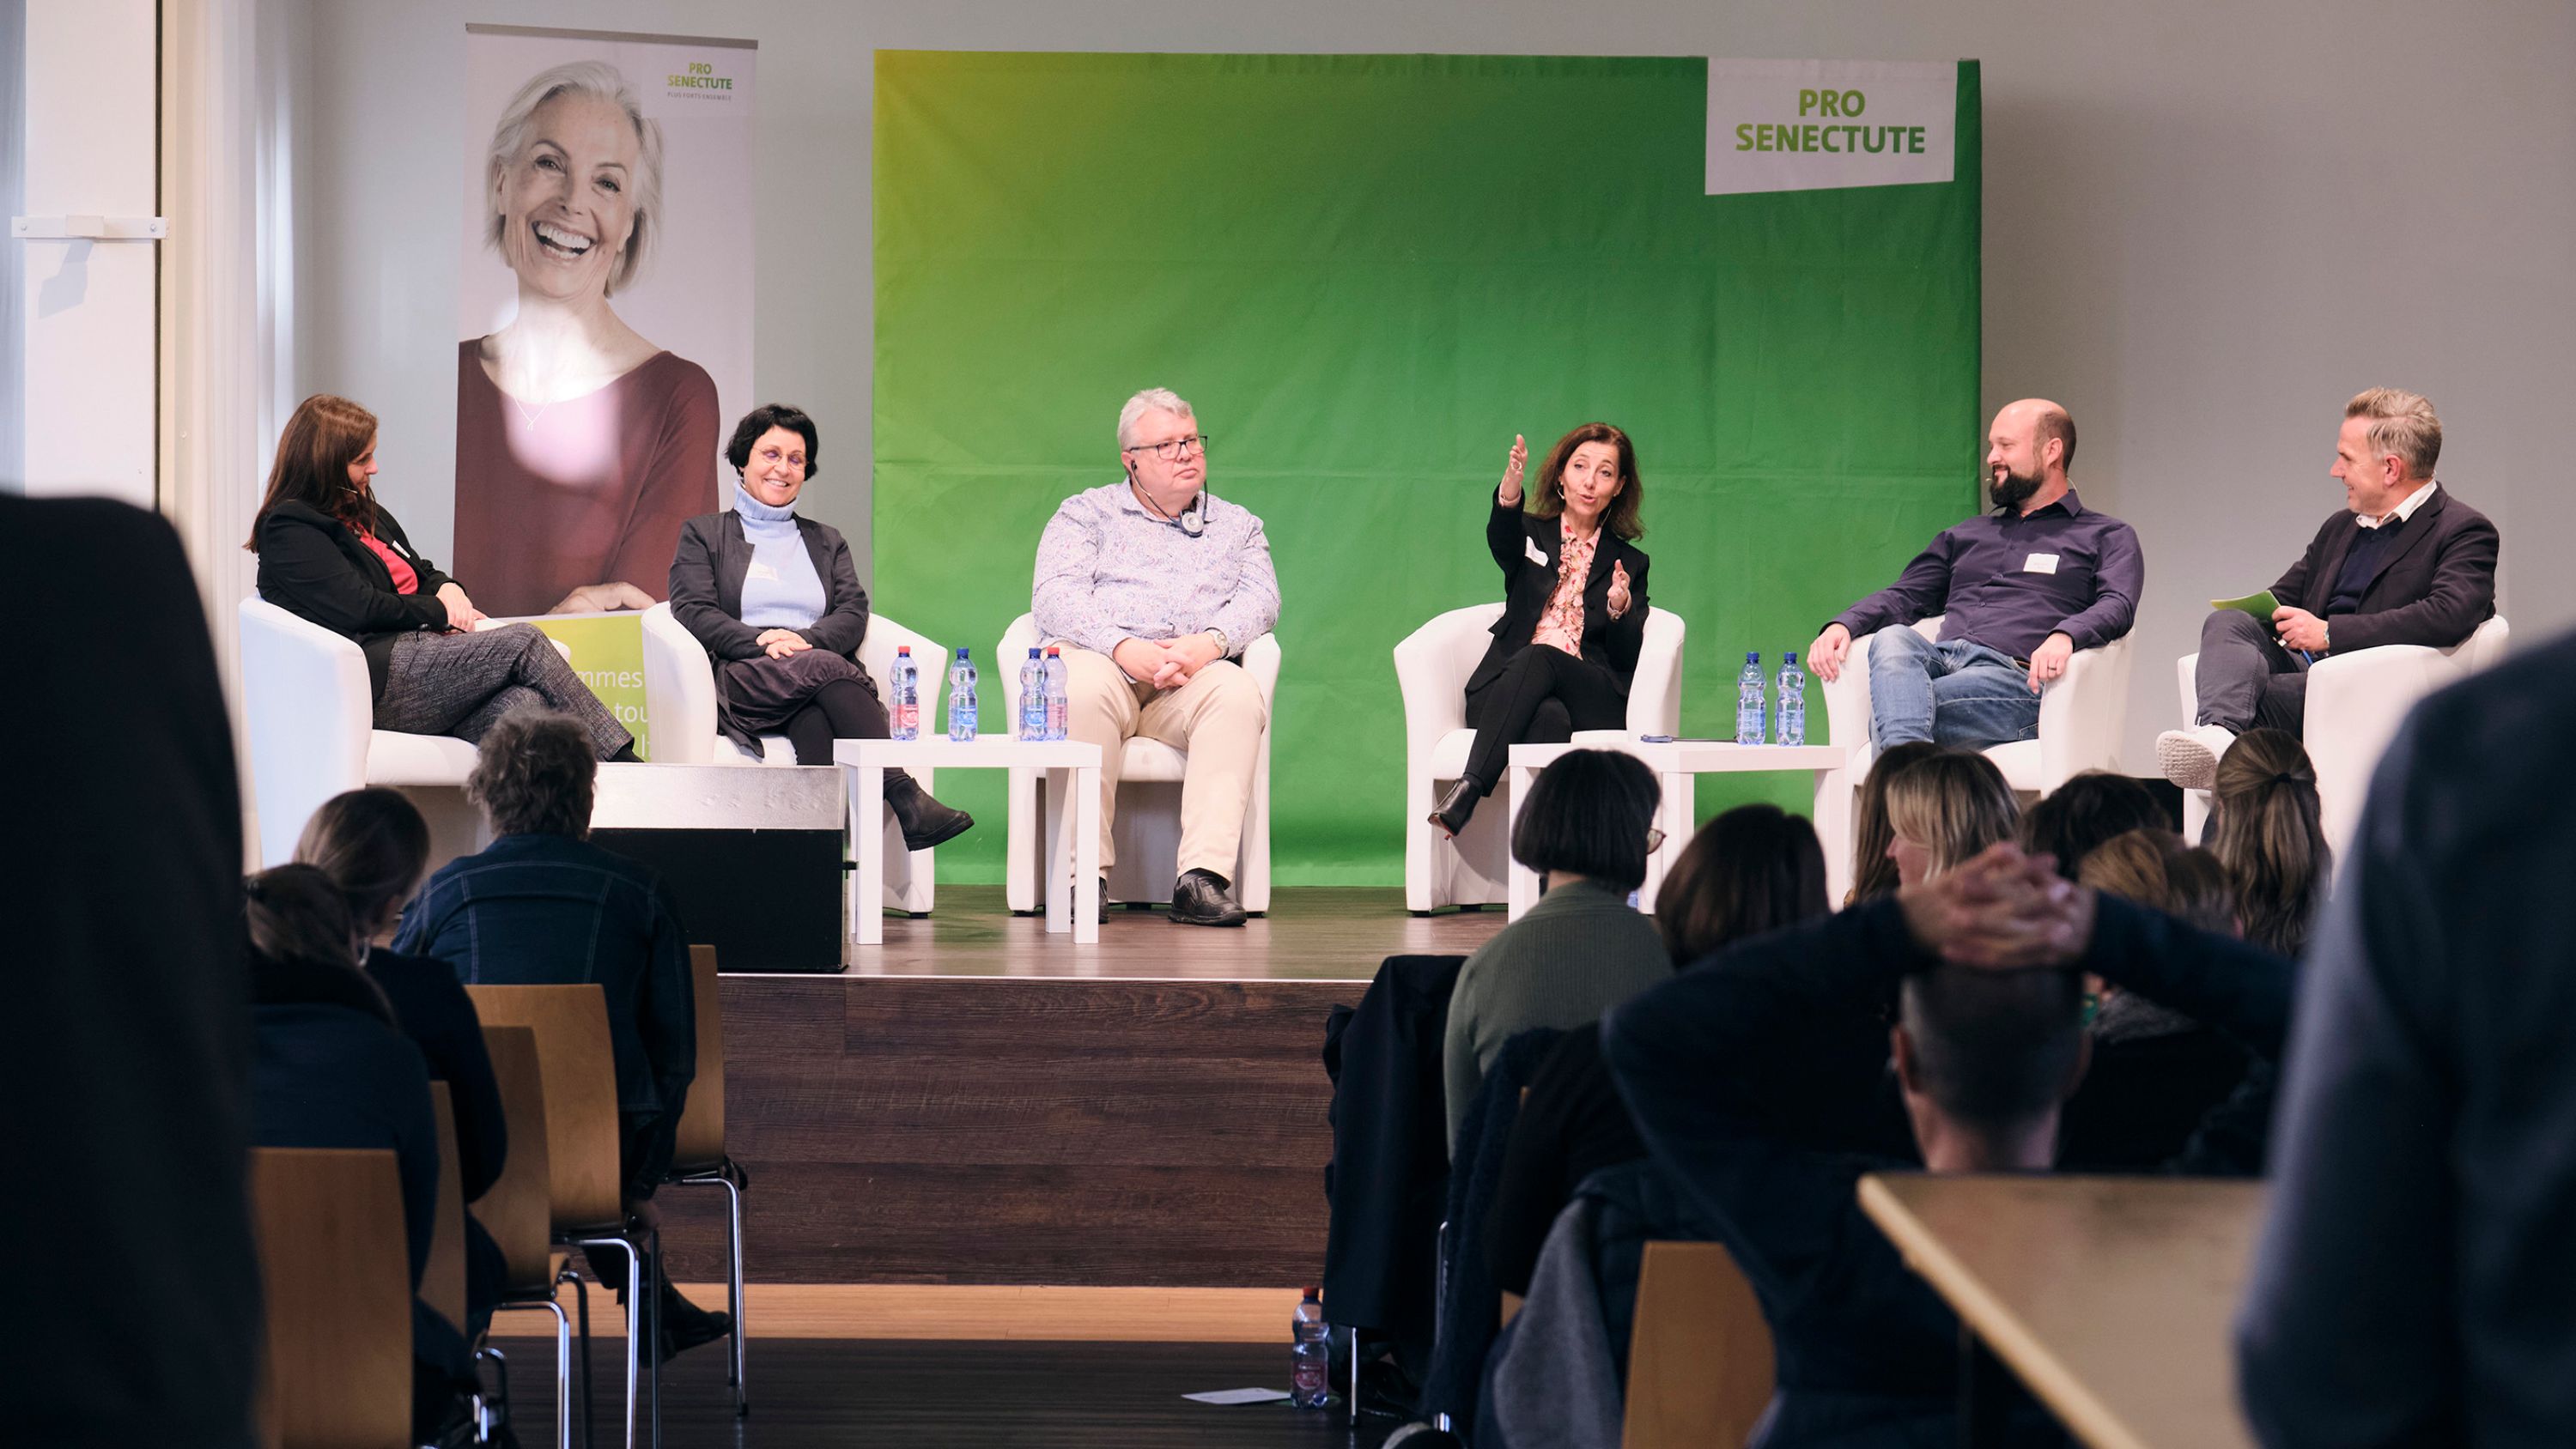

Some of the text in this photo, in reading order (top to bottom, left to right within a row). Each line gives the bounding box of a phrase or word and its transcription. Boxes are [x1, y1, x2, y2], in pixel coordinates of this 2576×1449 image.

[689, 63, 712, 75] PRO
[667, 75, 732, 90] SENECTUTE
[1799, 89, 1866, 118] PRO
[1735, 124, 1926, 154] SENECTUTE
